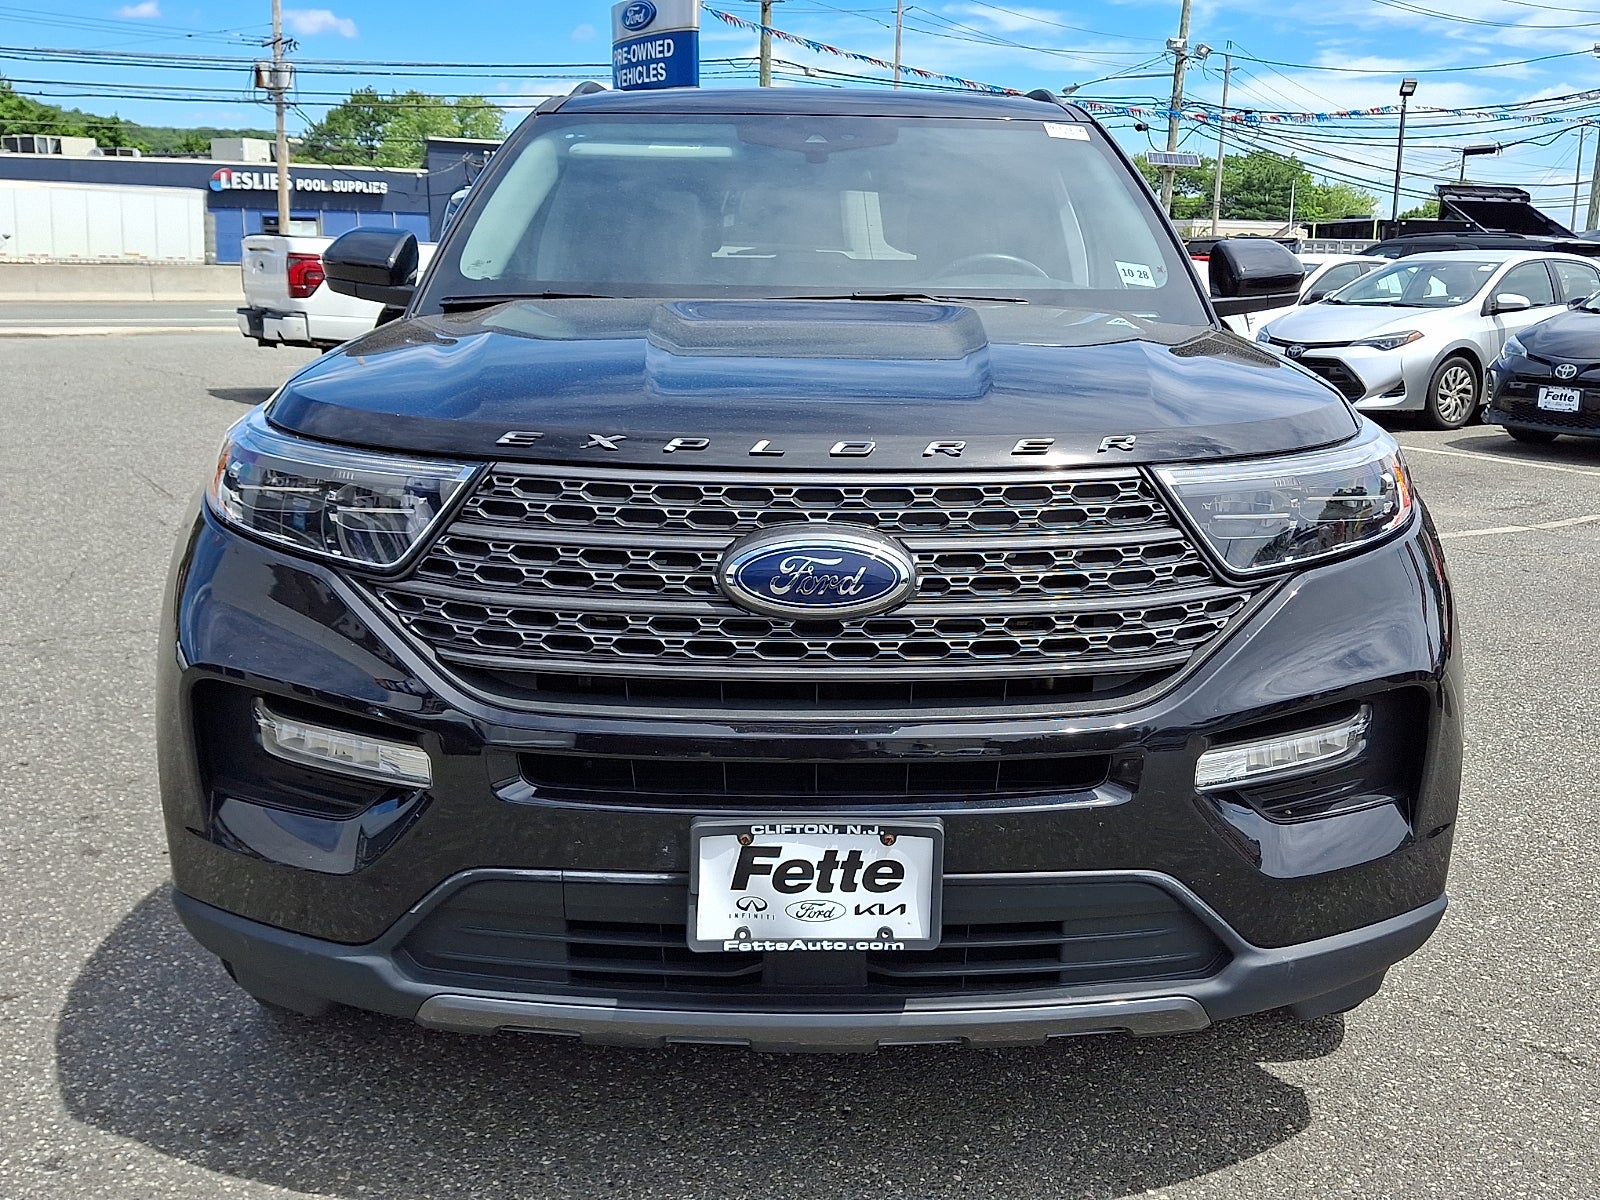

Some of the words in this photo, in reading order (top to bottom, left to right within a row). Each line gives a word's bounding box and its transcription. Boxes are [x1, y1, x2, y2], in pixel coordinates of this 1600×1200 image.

[625, 6, 645, 25] Ford
[614, 39, 674, 66] PRE-OWNED
[616, 62, 667, 88] VEHICLES
[220, 171, 293, 190] LESLIES
[296, 178, 329, 192] POOL
[332, 179, 388, 194] SUPPLIES
[1121, 268, 1134, 277] 10
[1136, 270, 1149, 279] 28
[1544, 391, 1574, 402] Fette
[495, 430, 1138, 459] EXPLORER
[769, 555, 868, 596] Ford
[750, 824, 839, 835] CLIFTON,
[846, 825, 885, 836] N.J.
[730, 845, 905, 894] Fette
[795, 902, 836, 919] Ford
[723, 939, 905, 951] FetteAuto.com
